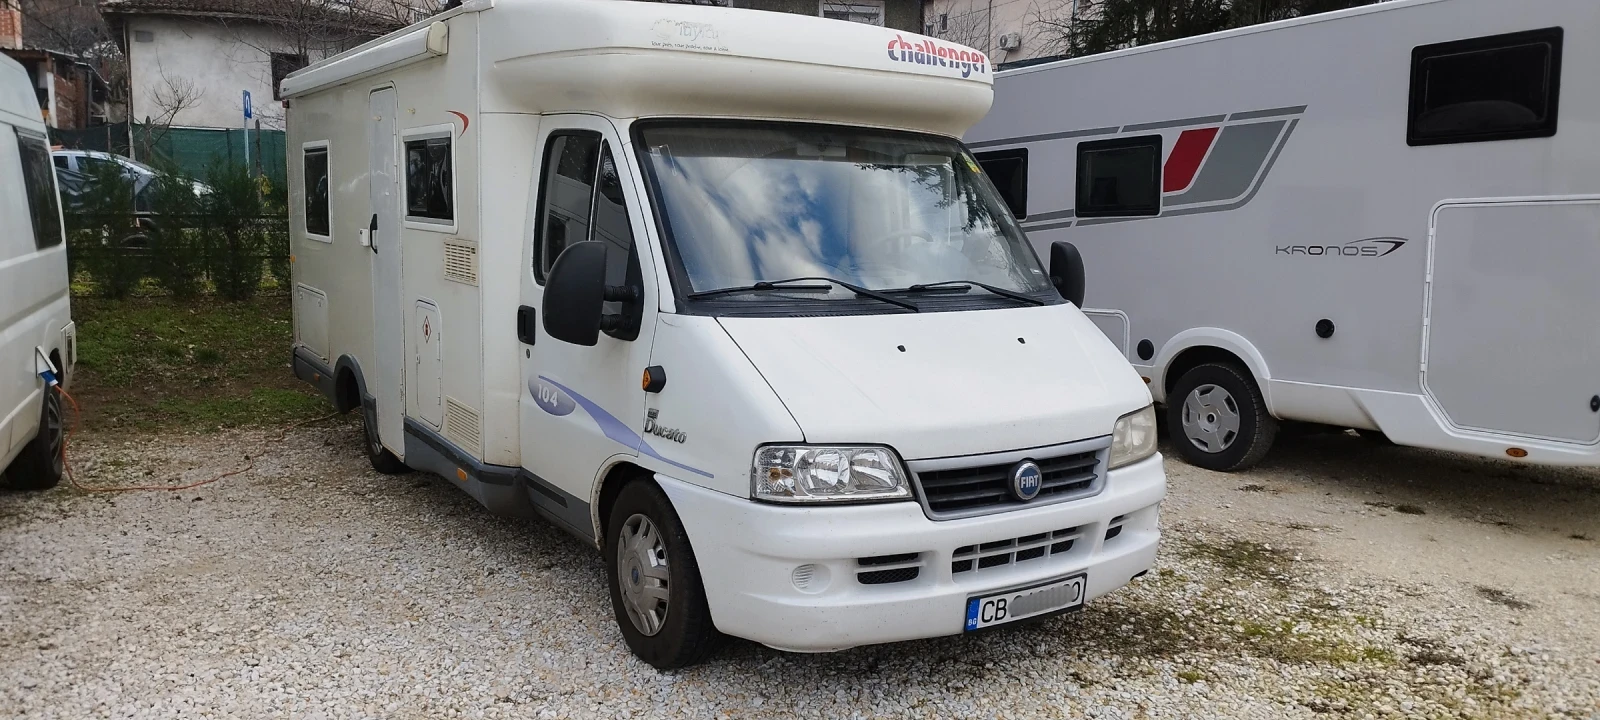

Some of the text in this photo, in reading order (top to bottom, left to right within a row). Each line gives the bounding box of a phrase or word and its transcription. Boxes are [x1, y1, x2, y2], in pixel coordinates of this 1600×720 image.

[888, 34, 985, 78] challenger
[1275, 245, 1378, 257] KRONOS
[537, 383, 559, 407] 104
[644, 417, 687, 444] Ducato
[1020, 474, 1039, 489] FIAT
[968, 617, 977, 626] BG
